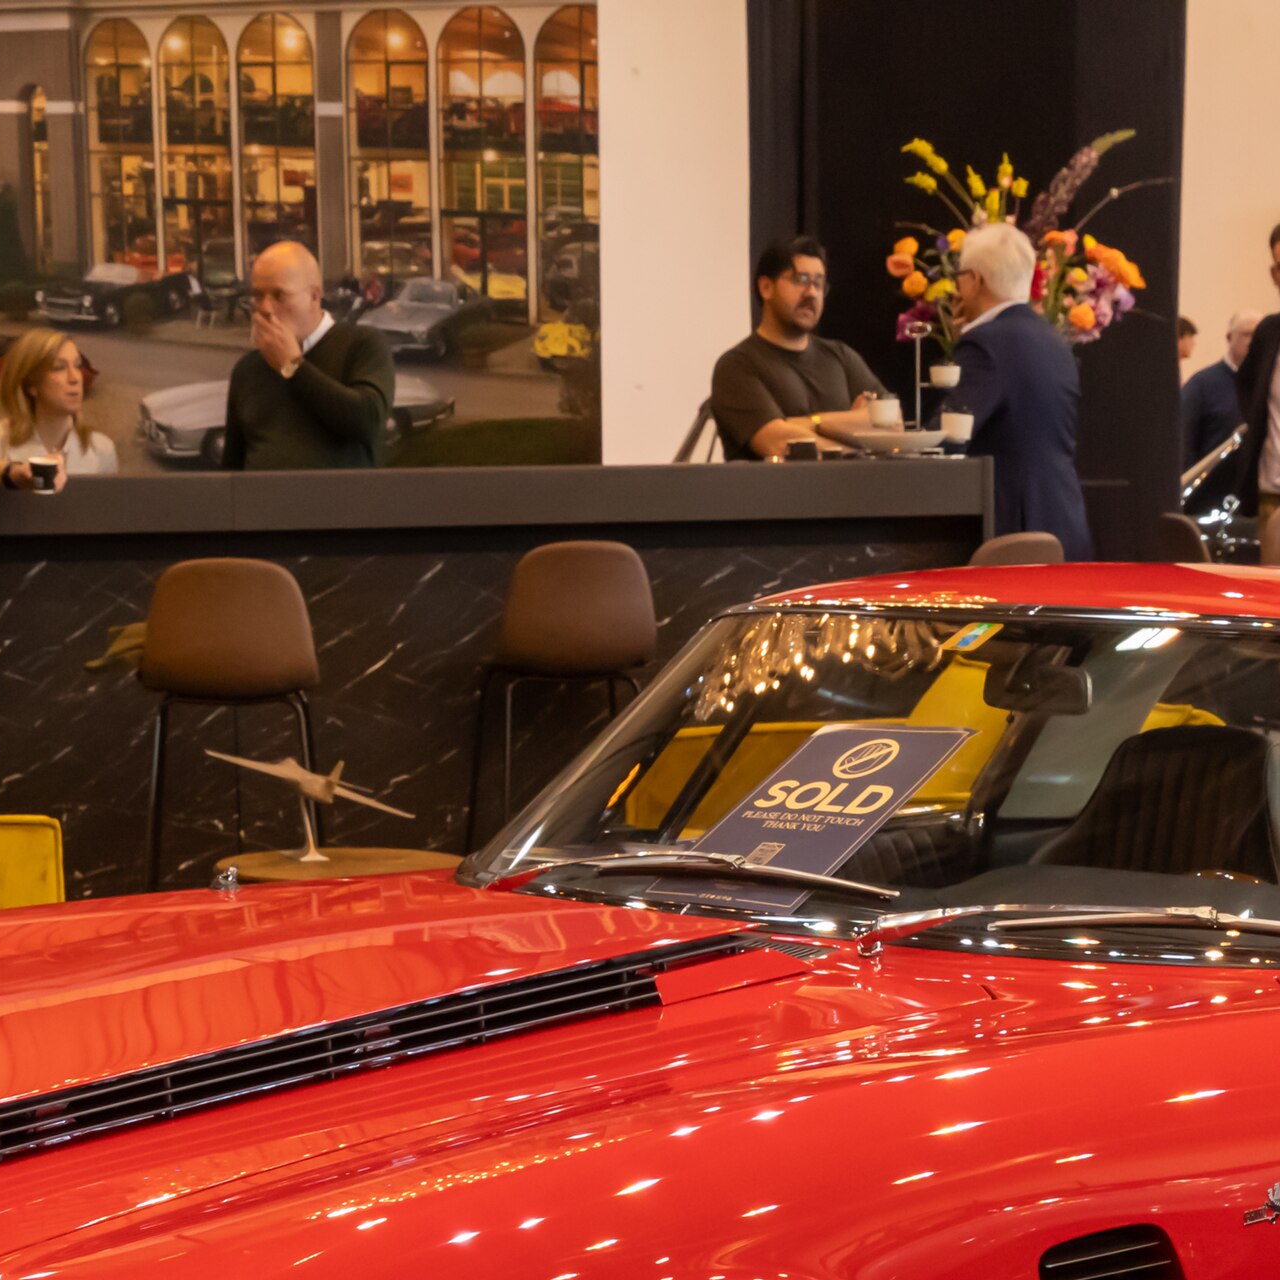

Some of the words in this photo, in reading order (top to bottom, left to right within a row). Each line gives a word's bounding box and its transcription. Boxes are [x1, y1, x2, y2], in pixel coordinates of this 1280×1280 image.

[753, 779, 895, 815] SOLD
[741, 810, 781, 820] PLEASE
[779, 812, 800, 822] DO
[798, 815, 822, 823] NOT
[822, 816, 865, 826] TOUCH
[762, 820, 801, 831] THANK
[802, 824, 826, 832] YOU
